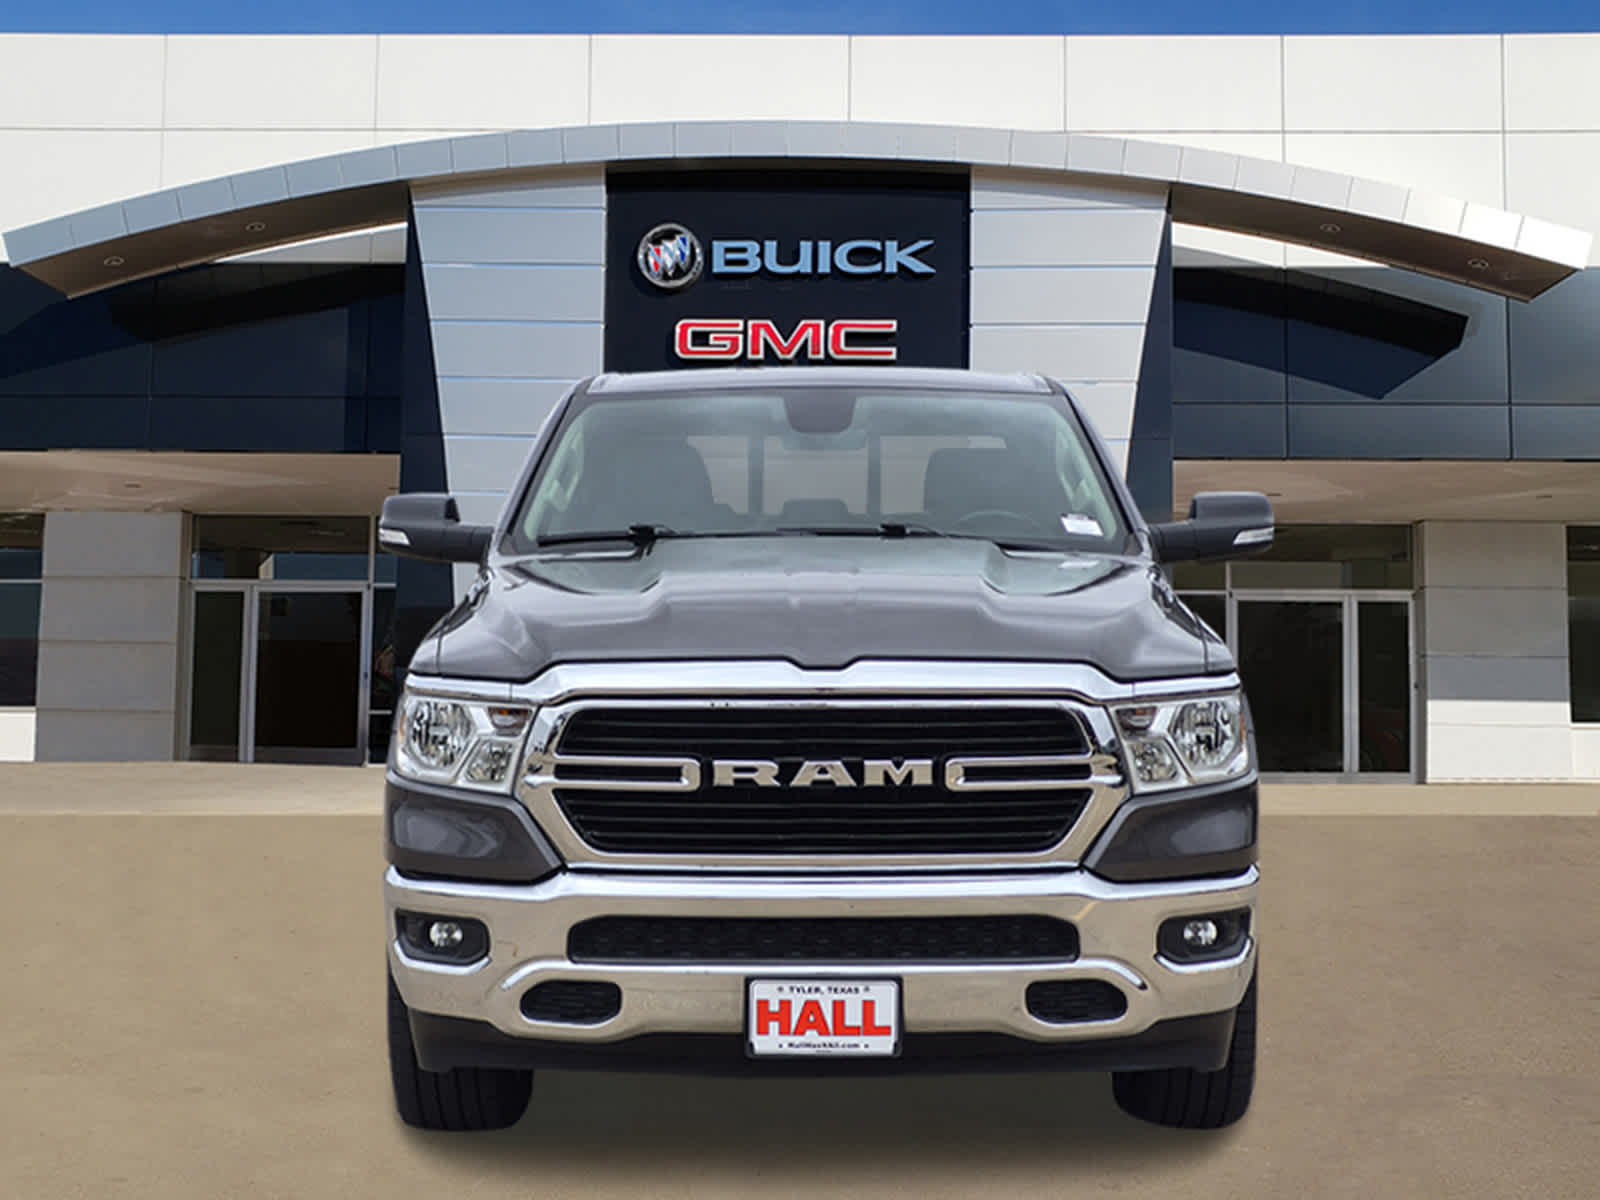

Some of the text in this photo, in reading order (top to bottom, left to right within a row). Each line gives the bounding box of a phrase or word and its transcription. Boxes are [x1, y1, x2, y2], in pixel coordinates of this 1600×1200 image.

[711, 240, 936, 274] BUICK
[674, 318, 898, 361] GMC
[712, 759, 933, 787] RAM
[828, 985, 860, 994] TEXAS
[756, 999, 892, 1036] HALL
